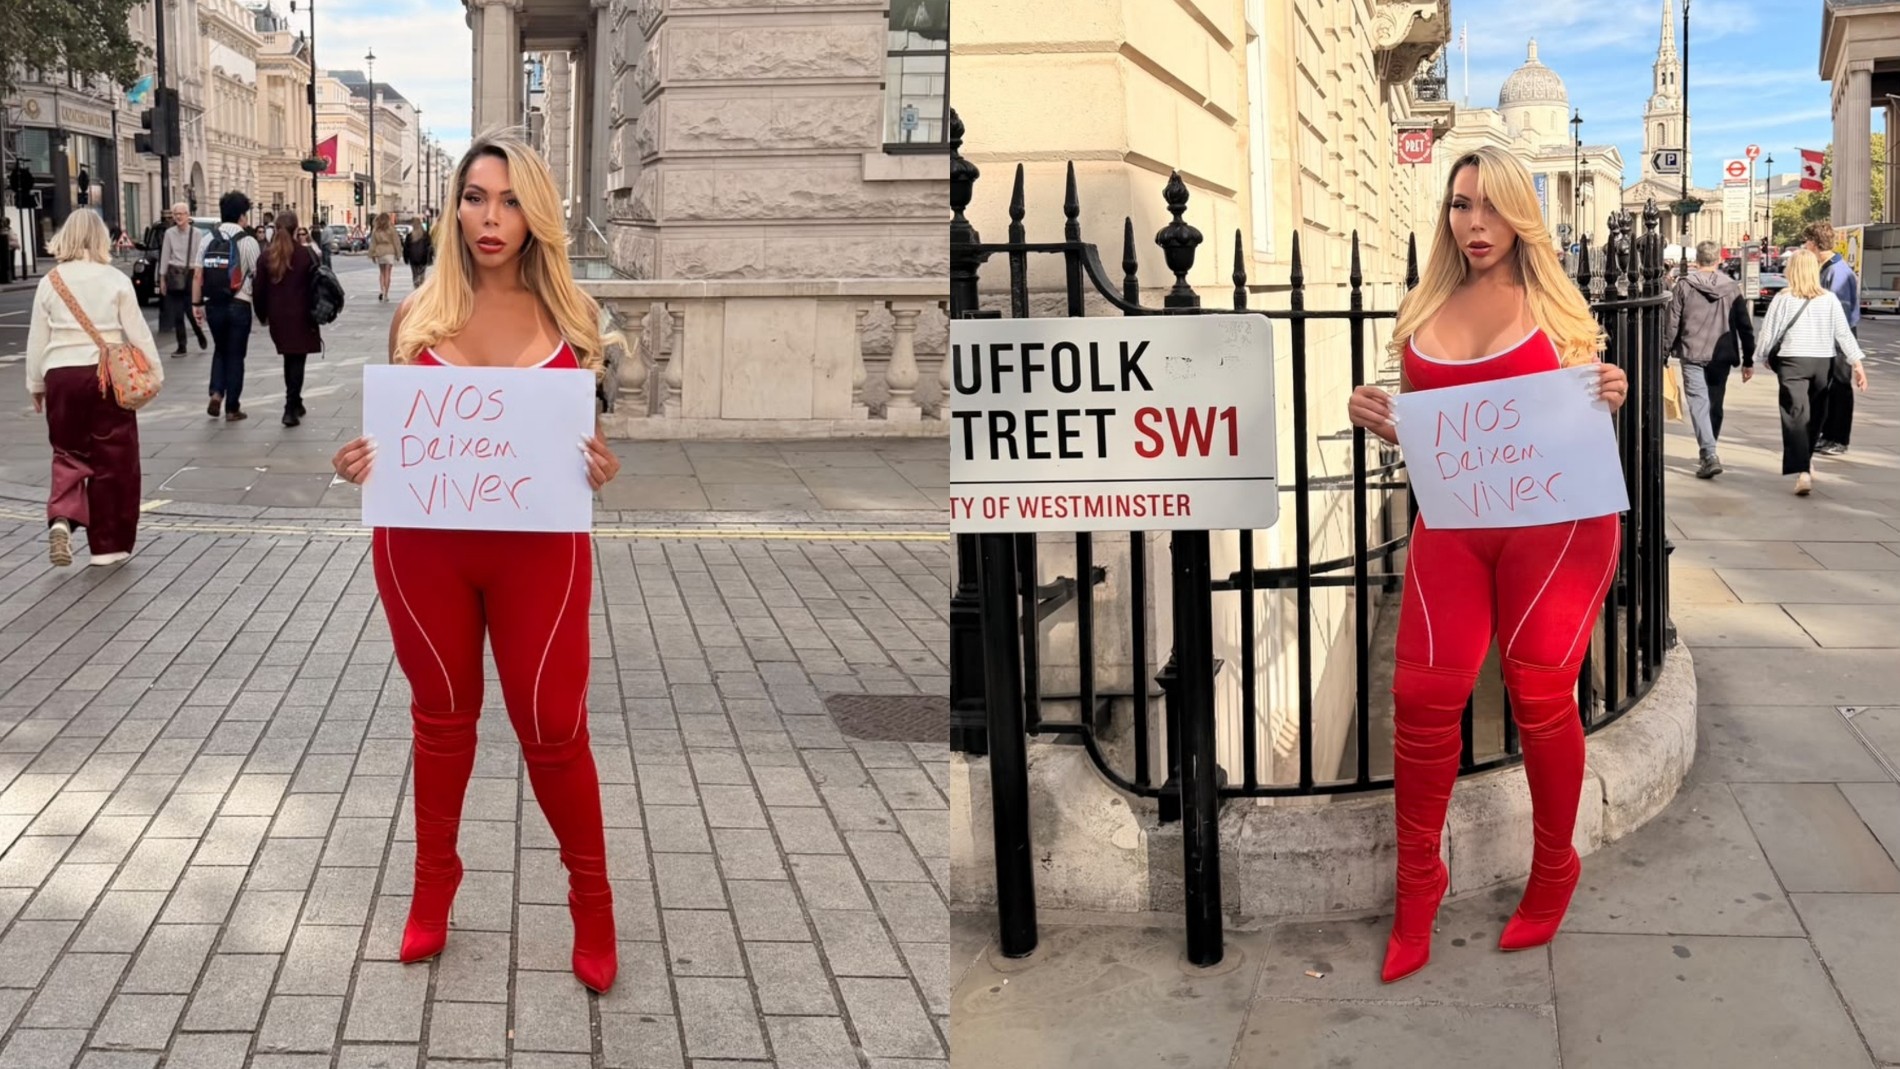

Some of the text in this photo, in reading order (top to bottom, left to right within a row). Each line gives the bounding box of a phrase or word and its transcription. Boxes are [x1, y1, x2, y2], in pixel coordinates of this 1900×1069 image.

[1667, 154, 1675, 165] P
[1749, 146, 1757, 157] Z
[952, 340, 1154, 396] UFFOLK
[404, 384, 504, 428] NOS
[1435, 399, 1521, 447] NOS
[952, 406, 1239, 461] TREET SW1
[983, 496, 1010, 519] OF
[1017, 494, 1191, 519] WESTMINSTER
